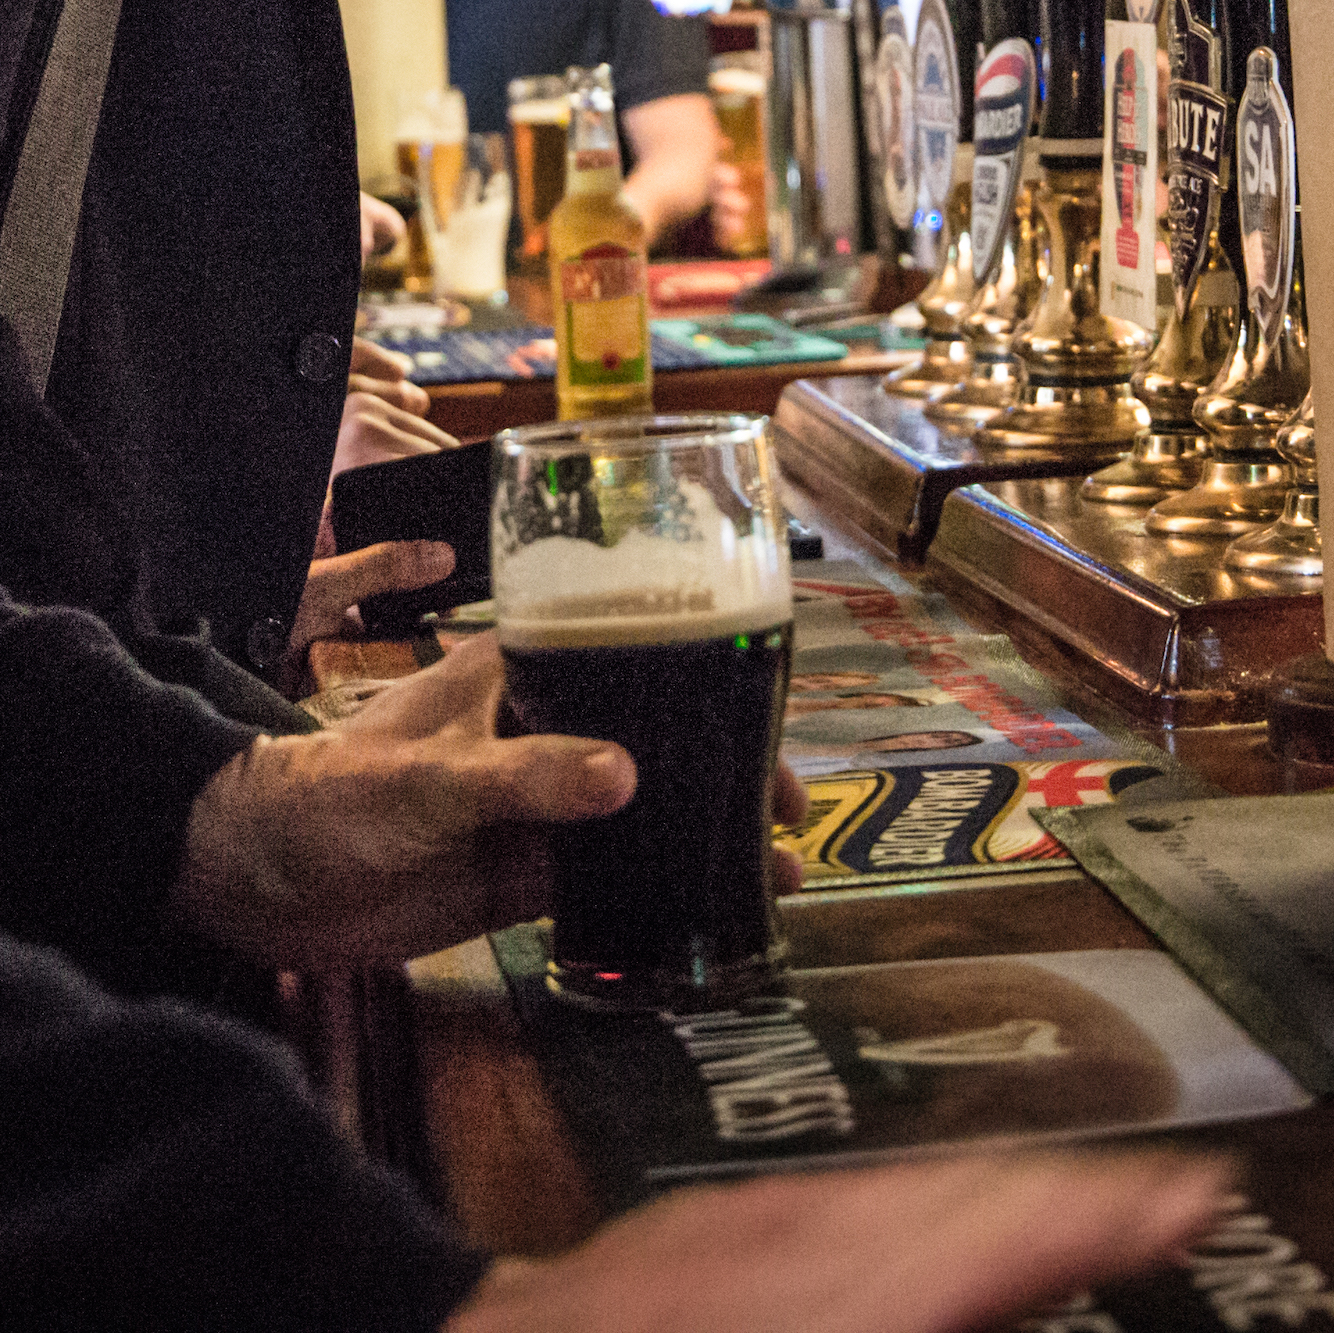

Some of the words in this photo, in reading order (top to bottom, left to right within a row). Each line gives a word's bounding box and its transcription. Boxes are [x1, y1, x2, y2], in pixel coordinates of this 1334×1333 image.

[1170, 99, 1221, 161] BUTE
[1245, 120, 1277, 197] SA
[869, 768, 993, 867] BOMBARDIER
